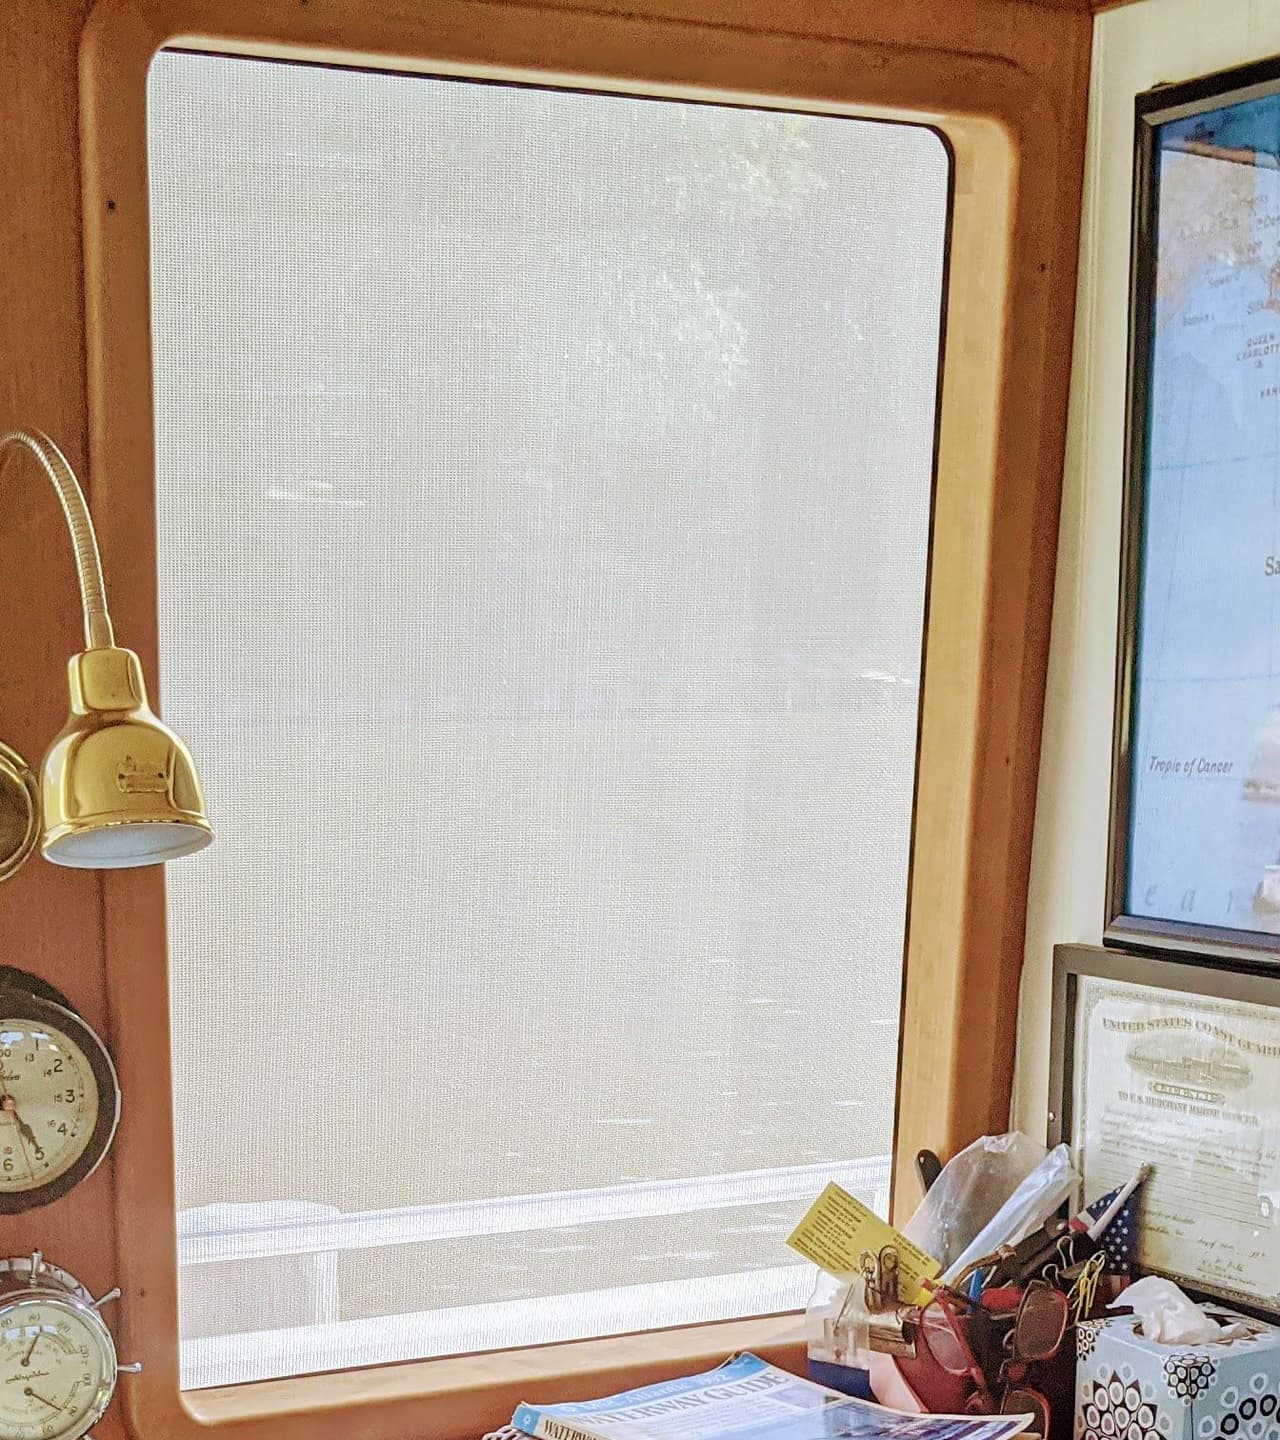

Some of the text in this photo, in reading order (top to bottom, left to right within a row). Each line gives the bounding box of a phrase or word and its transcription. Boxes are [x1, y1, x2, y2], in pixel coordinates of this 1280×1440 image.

[1149, 754, 1183, 775] Tropic
[1197, 756, 1234, 775] Cancer
[53, 1058, 64, 1073] 2
[65, 1089, 76, 1104] 3
[57, 1122, 68, 1136] 4
[34, 1147, 45, 1161] 5
[3, 1157, 14, 1172] 6
[573, 1371, 790, 1426] WATERWAY GUIDE
